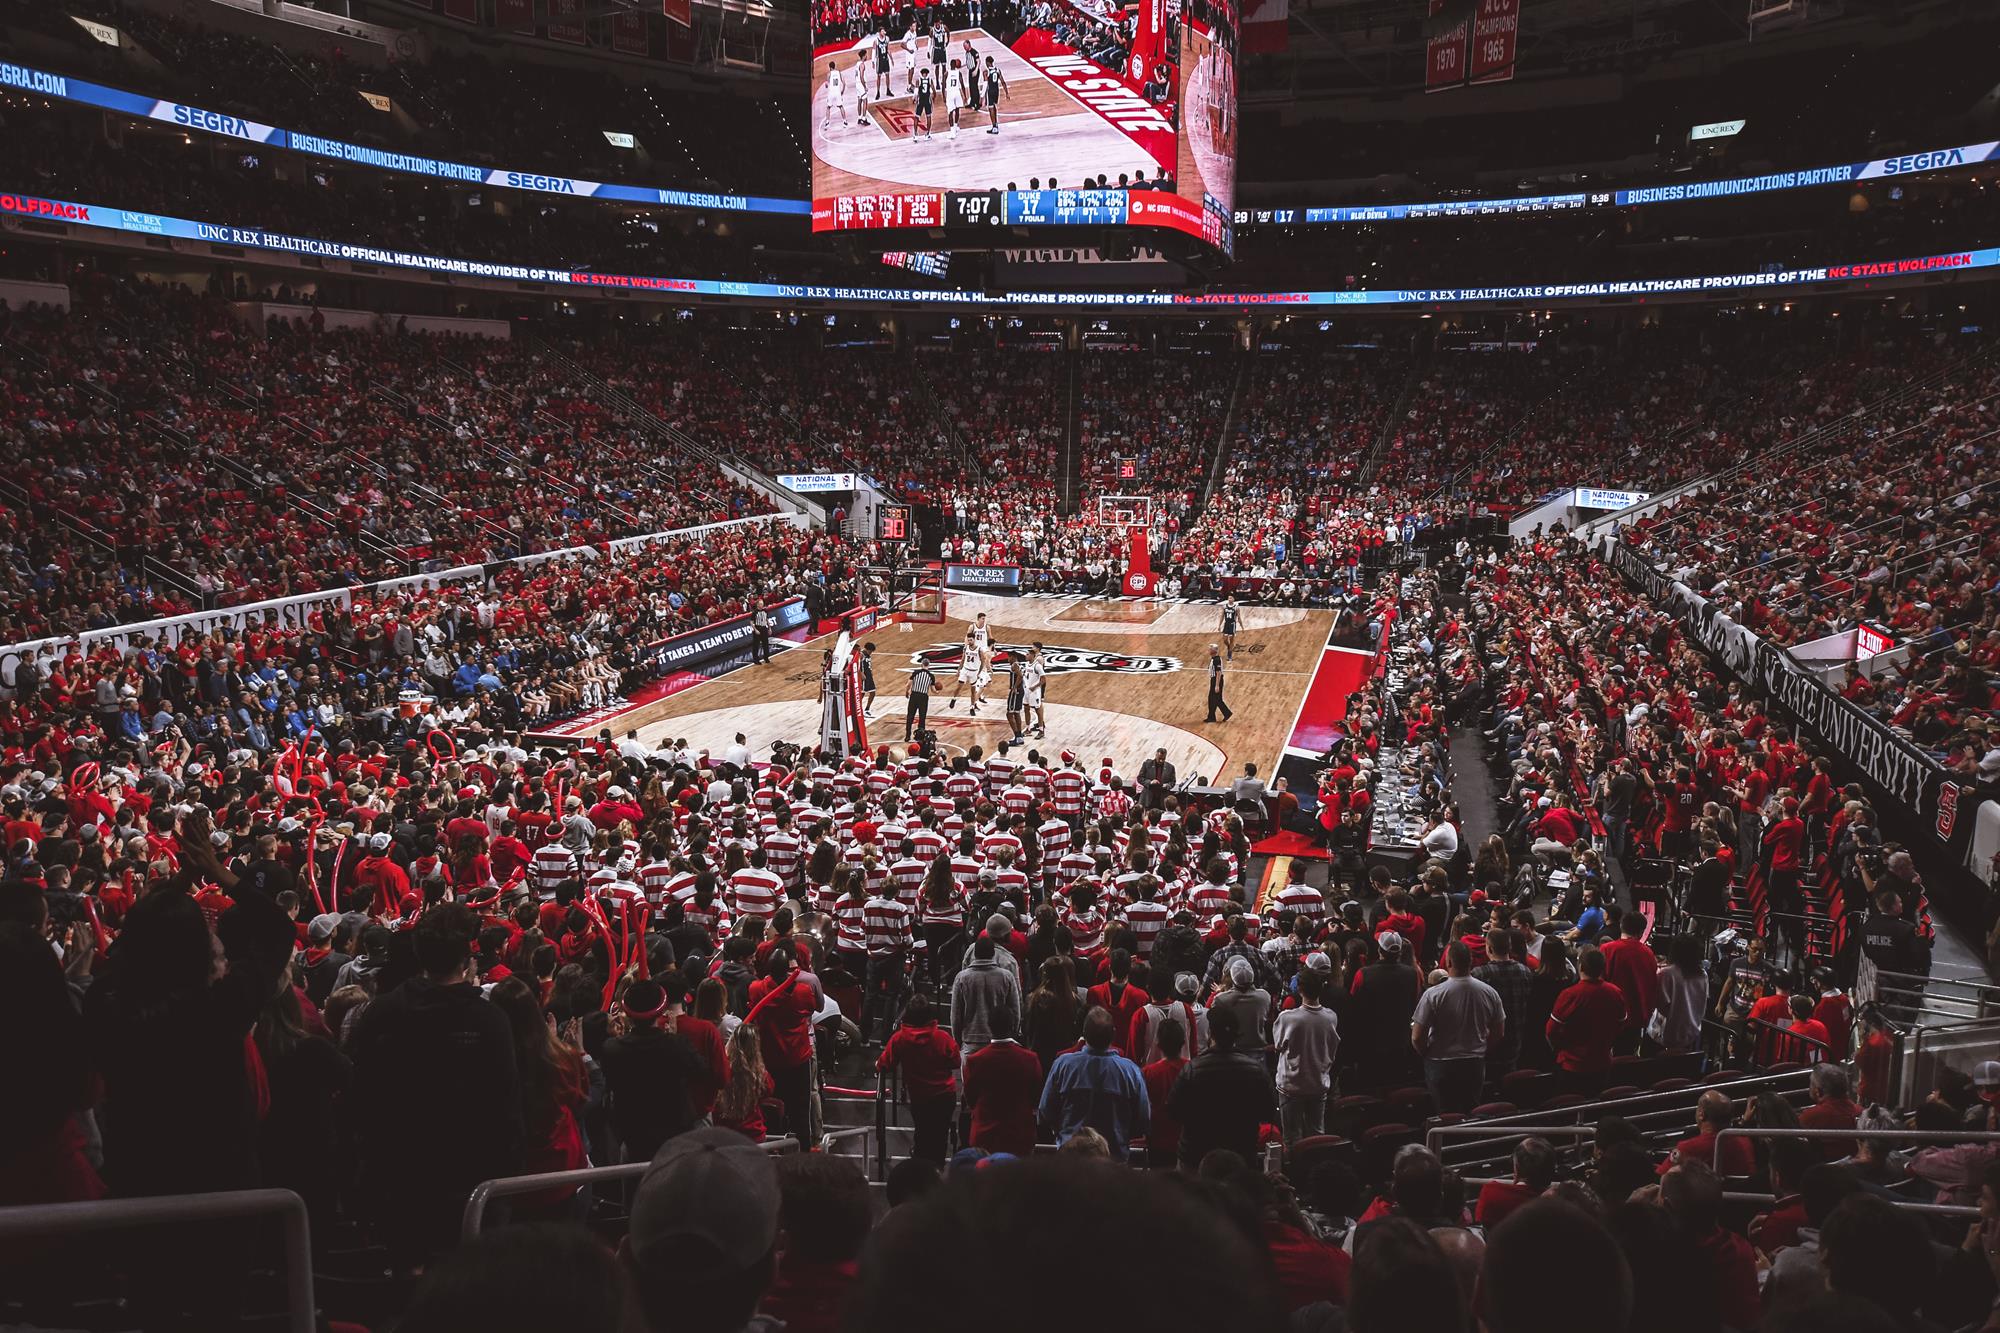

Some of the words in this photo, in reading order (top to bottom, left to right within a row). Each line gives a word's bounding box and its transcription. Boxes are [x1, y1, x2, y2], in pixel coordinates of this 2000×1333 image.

[1476, 14, 1515, 36] CHAMPIONS
[1437, 48, 1456, 71] 1970
[1483, 39, 1505, 62] 1965
[1030, 55, 1101, 76] NC
[0, 63, 66, 97] GRA.COM
[1064, 78, 1174, 133] STATE
[174, 103, 250, 138] SEGRA
[292, 132, 343, 158] BUSINESS
[344, 144, 437, 175] COMMUNICATIONS
[438, 161, 482, 182] PARTNER
[1884, 150, 1963, 174] SEGRA
[507, 172, 574, 194] SEGRA
[1627, 185, 1684, 204] BUSINESS
[1686, 173, 1795, 198] COMMUNICATIONS
[1797, 165, 1852, 186] PARTNER
[659, 190, 747, 210] WWW.SEGRA.COM
[904, 195, 914, 203] NC
[915, 194, 937, 202] STATE
[957, 197, 991, 214] 7:07
[1018, 192, 1041, 200] DUKE
[0, 195, 90, 221] OLFPACK
[911, 202, 929, 217] 29
[1022, 200, 1039, 214] 17
[1280, 210, 1294, 222] 17
[122, 212, 143, 224] UNC
[144, 214, 162, 226] REX
[198, 224, 228, 241] UNC
[233, 229, 260, 245] REX
[263, 234, 341, 256] HEALTHCARE
[342, 245, 394, 263] OFFICIAL
[395, 253, 468, 273] HEALTHCARE
[470, 262, 528, 278] PROVIDER
[530, 269, 546, 280] OF
[547, 270, 570, 282] THE
[571, 273, 588, 283] NC
[591, 274, 629, 286] STATE
[631, 277, 696, 290] WOLFPACK
[1398, 291, 1426, 301] UNC
[1430, 290, 1456, 300] REX
[1460, 287, 1541, 299] HEALTHCARE
[1544, 284, 1607, 296] OFFICIAL
[1609, 279, 1701, 293] HEALTHCARE
[1702, 272, 1775, 288] PROVIDER
[1778, 271, 1797, 283] OF
[1799, 269, 1826, 281] THE
[1828, 267, 1848, 278] NC
[1851, 262, 1895, 276] STATE
[1898, 253, 1972, 272] WOLFPACK
[778, 286, 803, 297] UNC
[807, 287, 831, 298] REX
[835, 288, 910, 300] HEALTHCARE
[912, 291, 970, 301] OFFICIAL
[972, 292, 1056, 303] HTHCARE
[1058, 294, 1124, 303] PROVIDER
[1126, 294, 1144, 303] OF
[1146, 294, 1172, 304] THE
[1238, 294, 1309, 303] WOLFPACK
[796, 475, 836, 483] NATIONAL
[796, 482, 836, 490] COATINGS
[1592, 491, 1630, 500] NATIONAL
[883, 518, 905, 539] 30
[962, 568, 983, 577] UNC
[985, 569, 1005, 578] REX
[657, 654, 667, 665] IT
[667, 645, 695, 662] TAKES
[694, 642, 702, 654] A
[700, 636, 723, 651] TEAM
[722, 631, 733, 642] TO
[733, 628, 743, 638] BE
[1858, 627, 1866, 646] NC
[1764, 651, 1779, 694] NC
[1779, 667, 1820, 726] STATE
[1818, 693, 1932, 815] UNIVERSITY
[1680, 793, 1692, 804] 20
[526, 825, 539, 841] 17
[255, 871, 266, 888] 3
[1866, 934, 1893, 947] POLICE
